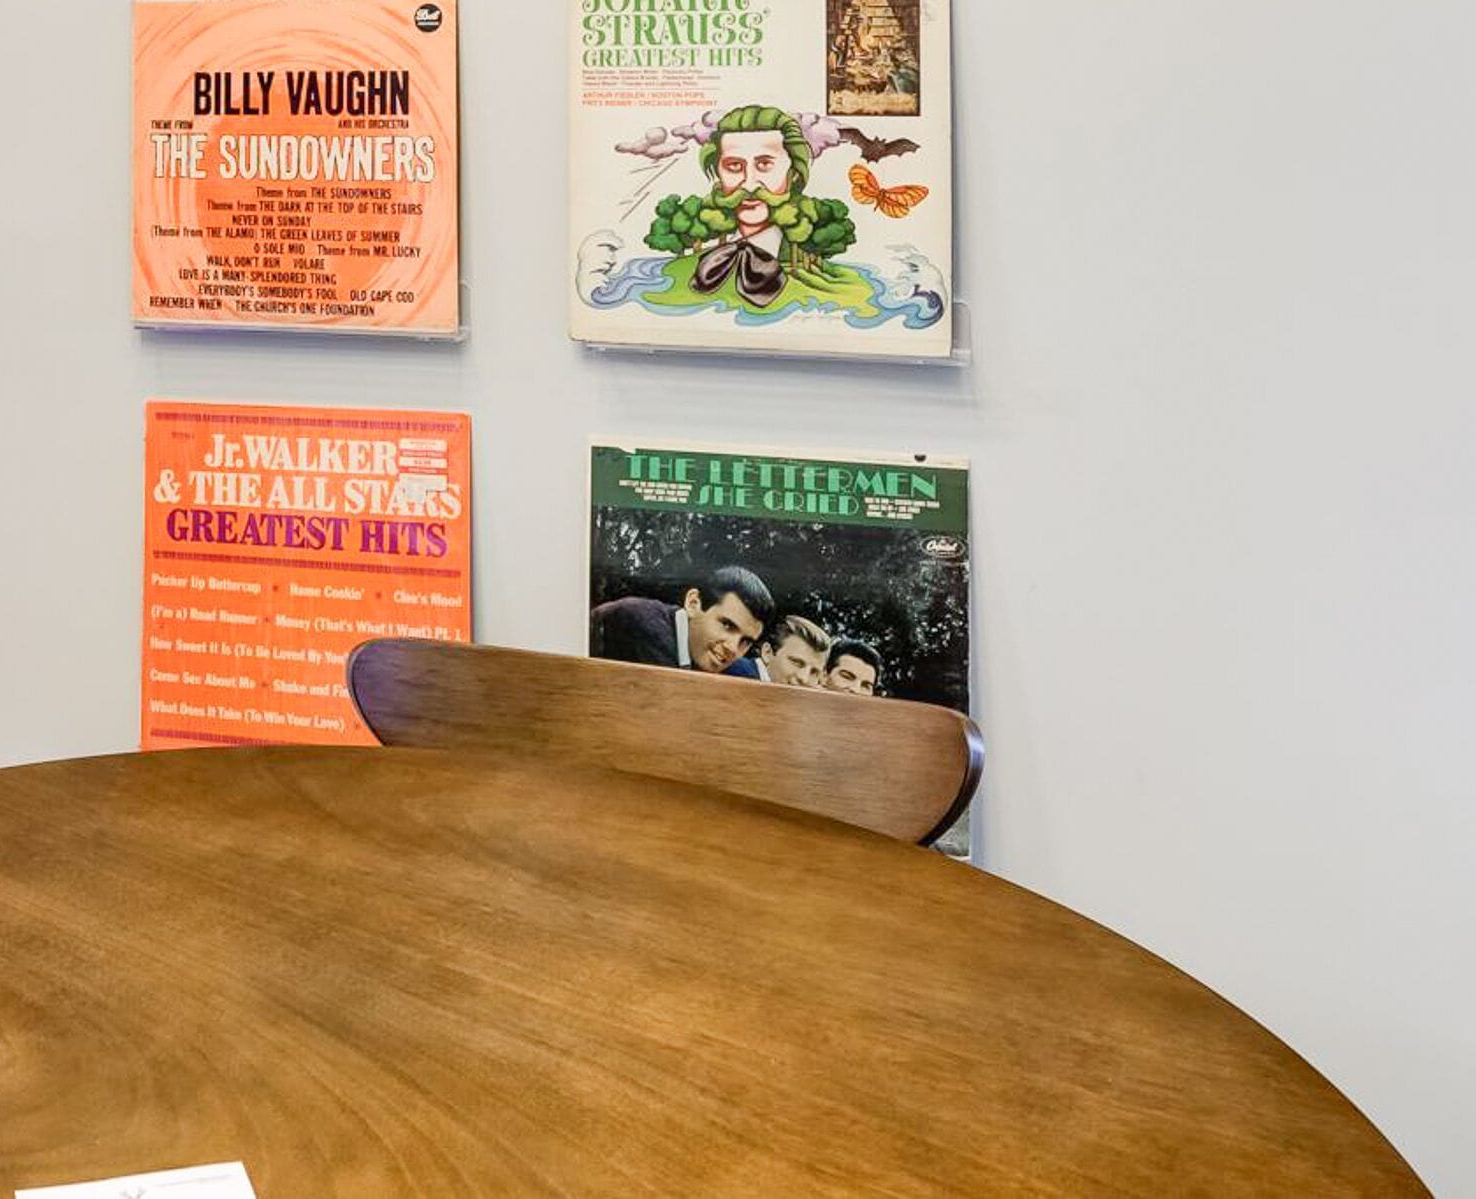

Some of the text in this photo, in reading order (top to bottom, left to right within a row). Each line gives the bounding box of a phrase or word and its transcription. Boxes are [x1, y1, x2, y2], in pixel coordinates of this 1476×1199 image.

[582, 47, 763, 68] GREATEST HITS
[194, 70, 409, 116] BILLY VAUGHN
[150, 132, 436, 183] THE SUNDOWNERS
[256, 186, 392, 200] Theme from THE SUNDOWNERS
[207, 199, 423, 215] Theme from THE DARK THE TOP THE STAIRS
[232, 214, 311, 228] NEVER ON SUNDAY
[183, 226, 203, 238] from
[206, 226, 222, 238] THE
[261, 228, 276, 240] THE
[280, 228, 308, 240] GREEN
[311, 229, 343, 241] LEAVES
[360, 230, 401, 243] SUMMER
[263, 242, 306, 256] SOLE MIO
[317, 243, 346, 256] Theme
[349, 244, 370, 256] from
[392, 246, 422, 258] LUCKY
[234, 256, 260, 268] DON'T
[293, 258, 325, 270] VOLARE
[179, 267, 199, 280] LOVE
[311, 273, 337, 286] THING
[198, 284, 338, 301] EVERYBODY'S SOMEBODY'S FOOL
[350, 289, 367, 302] OLD
[371, 290, 393, 303] CAPE
[149, 296, 223, 311] REMEMBER WHEN
[235, 300, 376, 317] THE CHURCH'S ONE FOUNDATION
[626, 454, 697, 484] THE
[709, 459, 937, 500] LETTERMEN
[153, 469, 181, 504] &
[188, 471, 262, 508] THE
[266, 476, 337, 513] ALL
[695, 484, 755, 509] SHE
[763, 489, 860, 517] CRIED
[167, 507, 448, 558] GREATEST HITS
[356, 619, 386, 636] What
[273, 646, 306, 662] Loved
[150, 667, 180, 682] Come
[182, 670, 202, 685] See
[204, 672, 236, 688] About
[273, 678, 308, 694] Shake
[150, 699, 177, 714] What
[218, 705, 242, 720] Take
[264, 711, 286, 725] Win
[287, 711, 313, 727] Your
[315, 715, 345, 733] Love)
